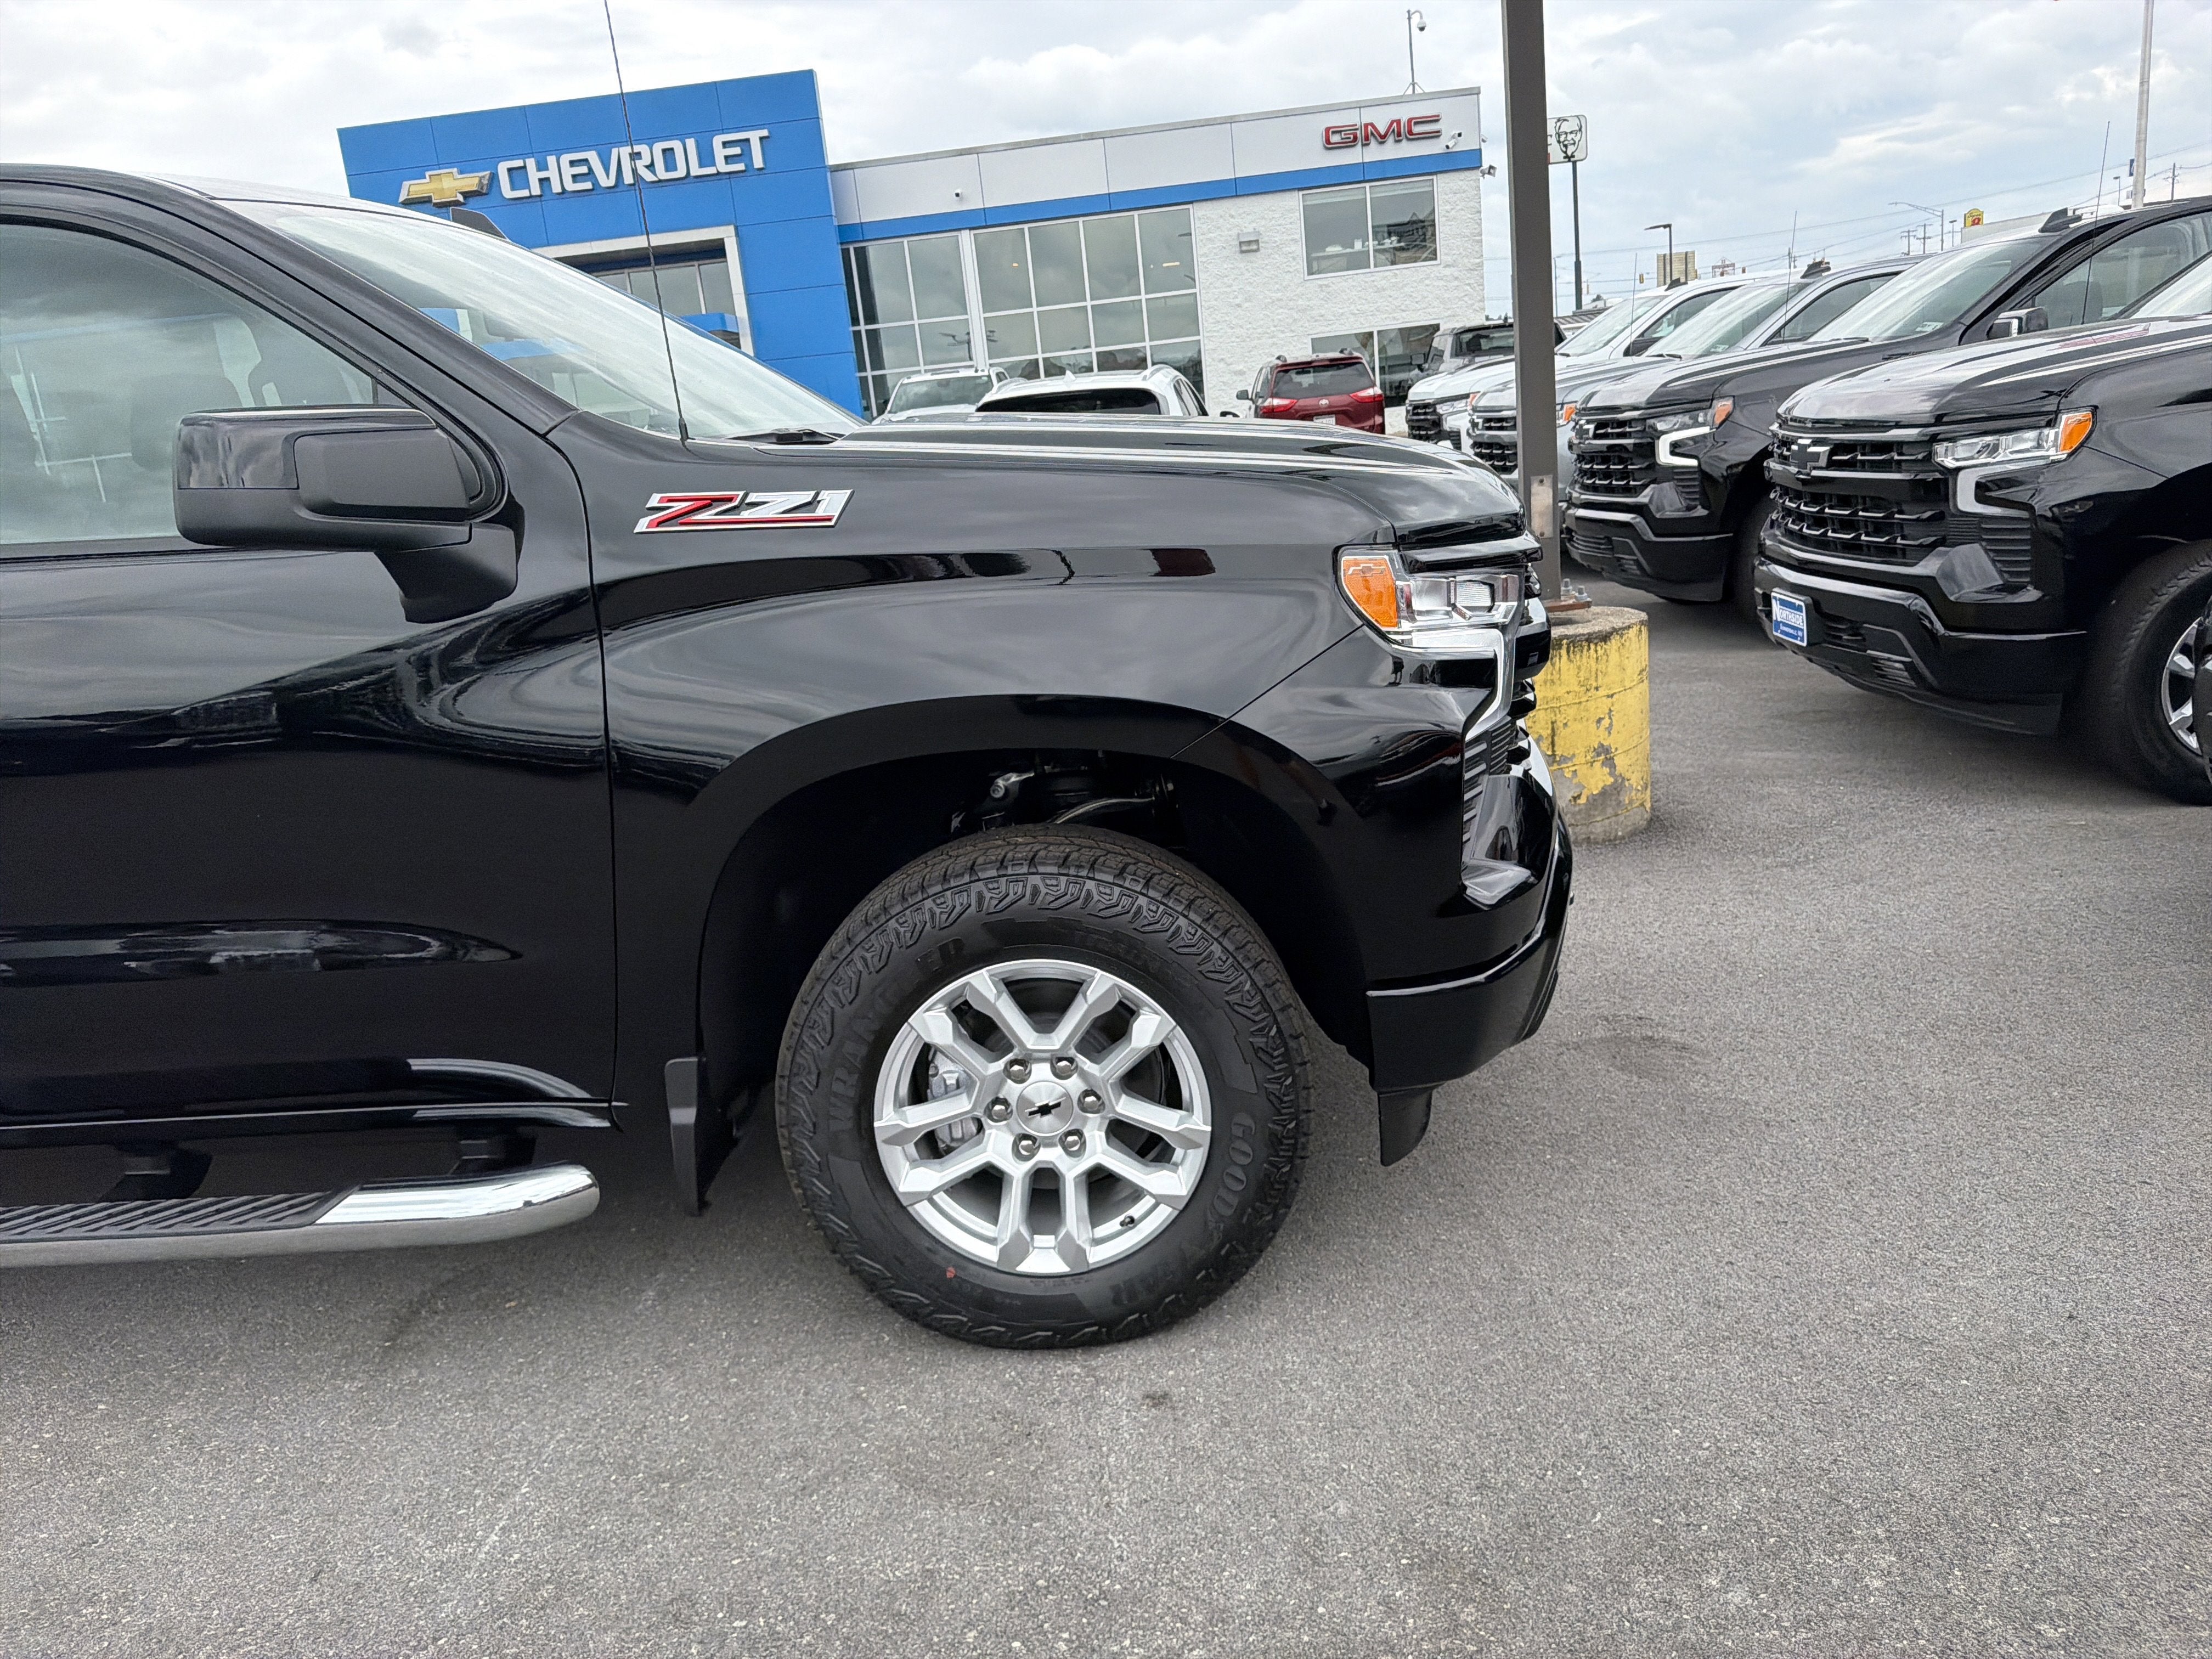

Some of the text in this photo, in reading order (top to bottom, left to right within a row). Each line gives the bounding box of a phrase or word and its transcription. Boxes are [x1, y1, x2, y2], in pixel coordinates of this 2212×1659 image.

[1323, 114, 1442, 149] GMC
[498, 129, 770, 200] CHEVROLET
[634, 489, 855, 534] Z71
